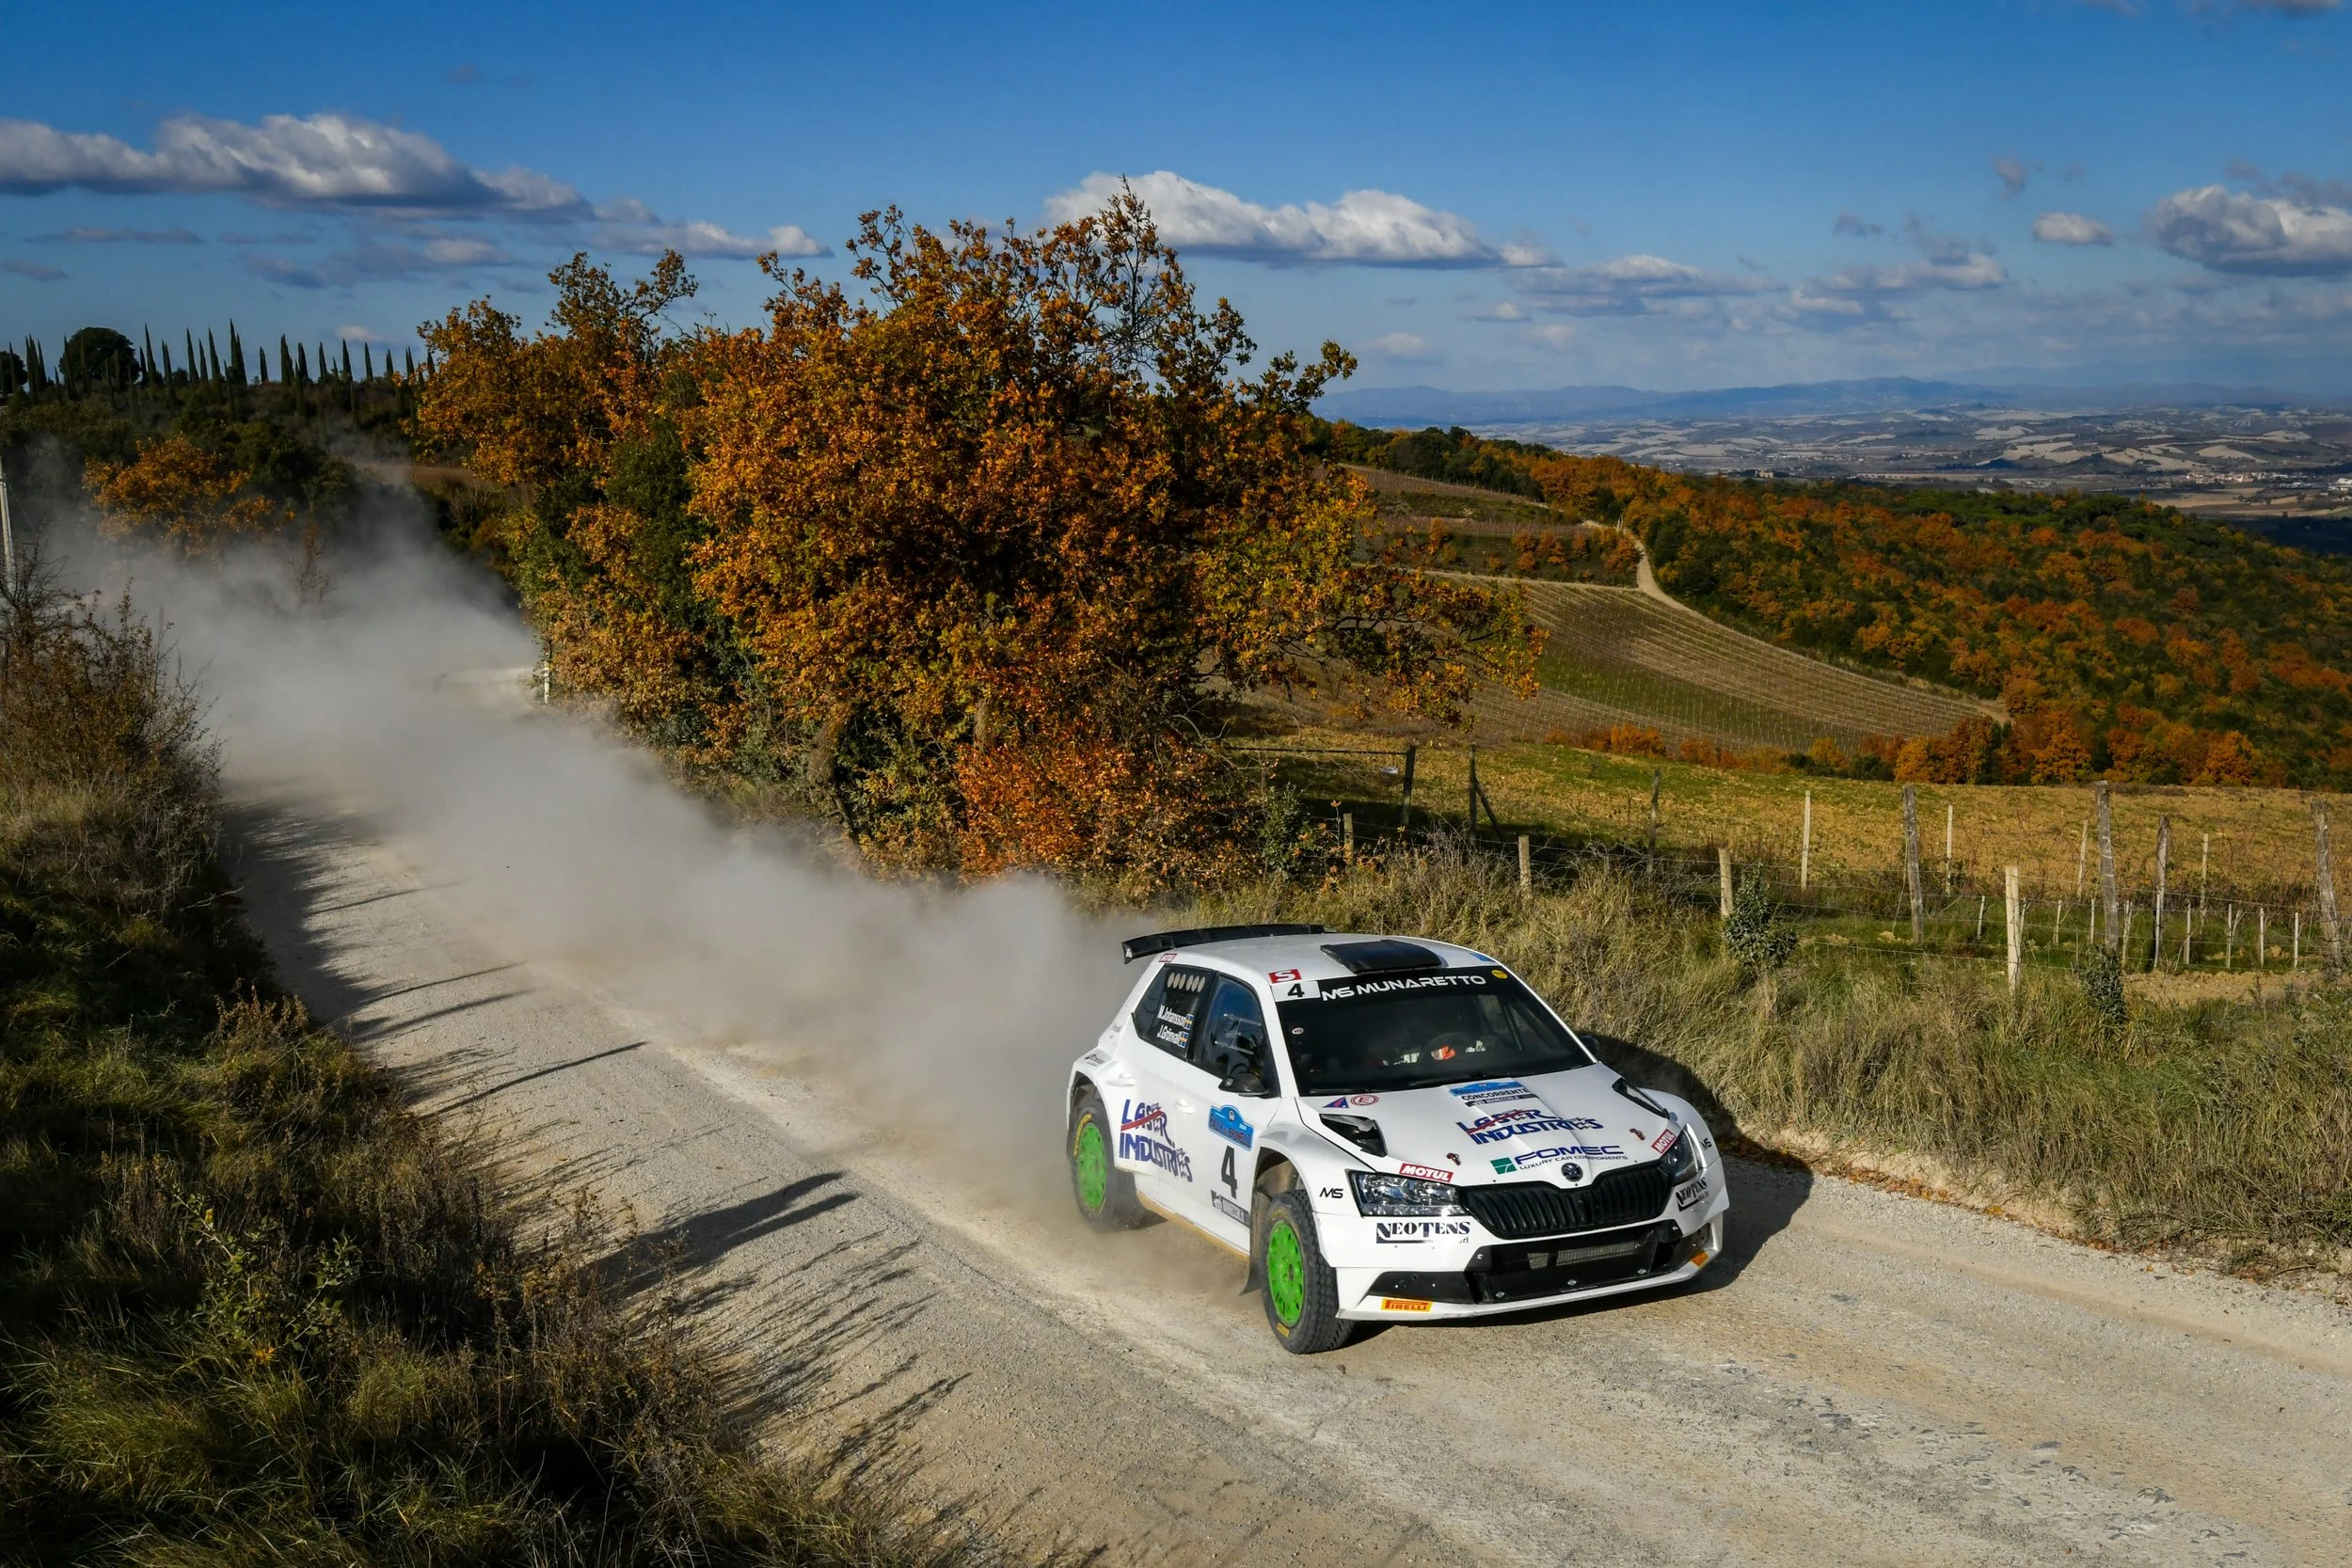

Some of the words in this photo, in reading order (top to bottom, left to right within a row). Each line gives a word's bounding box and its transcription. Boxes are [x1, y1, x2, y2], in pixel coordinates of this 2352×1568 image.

[1287, 983, 1305, 998] 4
[1321, 987, 1355, 1002] MS
[1356, 975, 1486, 994] MUNARETTO
[1461, 1088, 1530, 1101] CONCORRENTE
[1120, 1099, 1172, 1147] LASER
[1456, 1109, 1556, 1134] LASER
[1470, 1117, 1604, 1145] INDUSTRIES
[1119, 1132, 1193, 1182] INDUSTRIES
[1515, 1146, 1624, 1165] FOMEC
[1519, 1159, 1552, 1170] LUXURY
[1221, 1145, 1238, 1199] 4
[1401, 1164, 1450, 1180] MOTUL
[1319, 1187, 1343, 1198] MS
[1376, 1222, 1470, 1239] NEOTENS
[1385, 1299, 1429, 1310] PIRELLI
